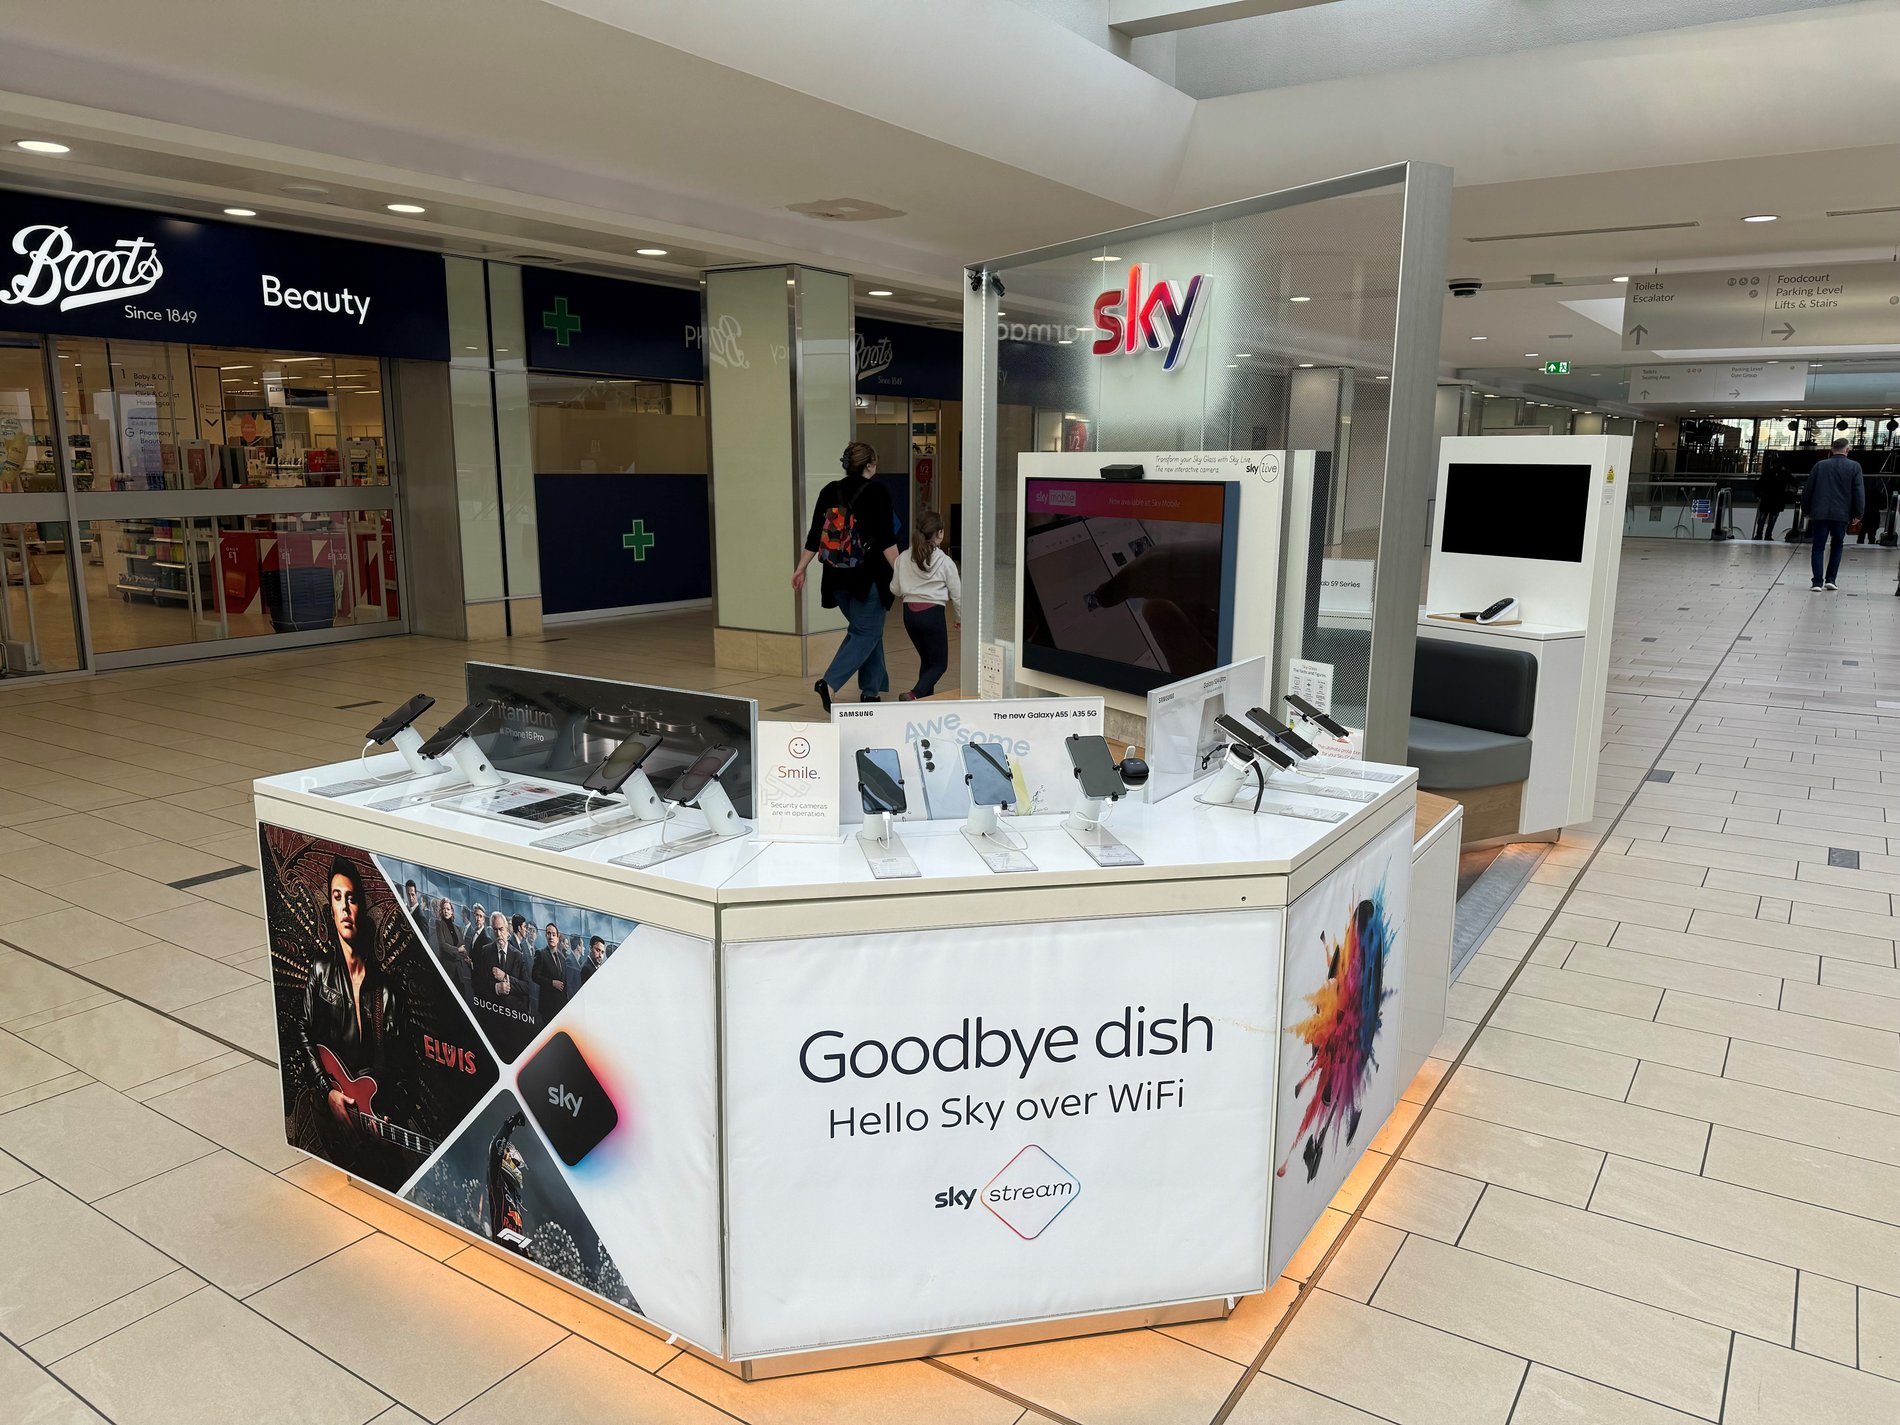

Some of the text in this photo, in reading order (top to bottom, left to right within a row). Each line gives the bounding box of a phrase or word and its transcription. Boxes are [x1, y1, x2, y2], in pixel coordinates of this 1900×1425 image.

[0, 225, 163, 312] Boots
[1777, 274, 1830, 284] Foodcourt
[1634, 282, 1664, 291] Toilets
[1776, 285, 1843, 297] Parking Level
[262, 274, 371, 324] Beauty
[1632, 293, 1675, 303] Escalator
[1774, 298, 1838, 309] Lifts & Stairs
[124, 304, 197, 324] Since 1849
[1093, 262, 1213, 371] sky
[139, 429, 171, 437] Pharmacy
[1229, 455, 1239, 466] Sky
[1246, 462, 1278, 475] sky live
[839, 710, 874, 718] SAMSUNG
[993, 712, 1007, 720] The
[1027, 711, 1054, 720] Galaxy
[1055, 710, 1069, 718] A55
[1072, 710, 1086, 718] A35
[504, 728, 545, 742] iPhone 15 Pro
[905, 712, 961, 744] Awe
[955, 727, 1031, 758] some
[778, 765, 821, 779] Smile.
[770, 801, 798, 809] Security
[472, 996, 536, 1025] SUCCESSION
[799, 1002, 1214, 1083] Goodbye dish
[424, 1034, 477, 1075] ELVIS
[547, 1084, 584, 1117] sky
[829, 1078, 1184, 1139] Hello Sky over WiFi
[934, 1179, 1073, 1210] sky stream
